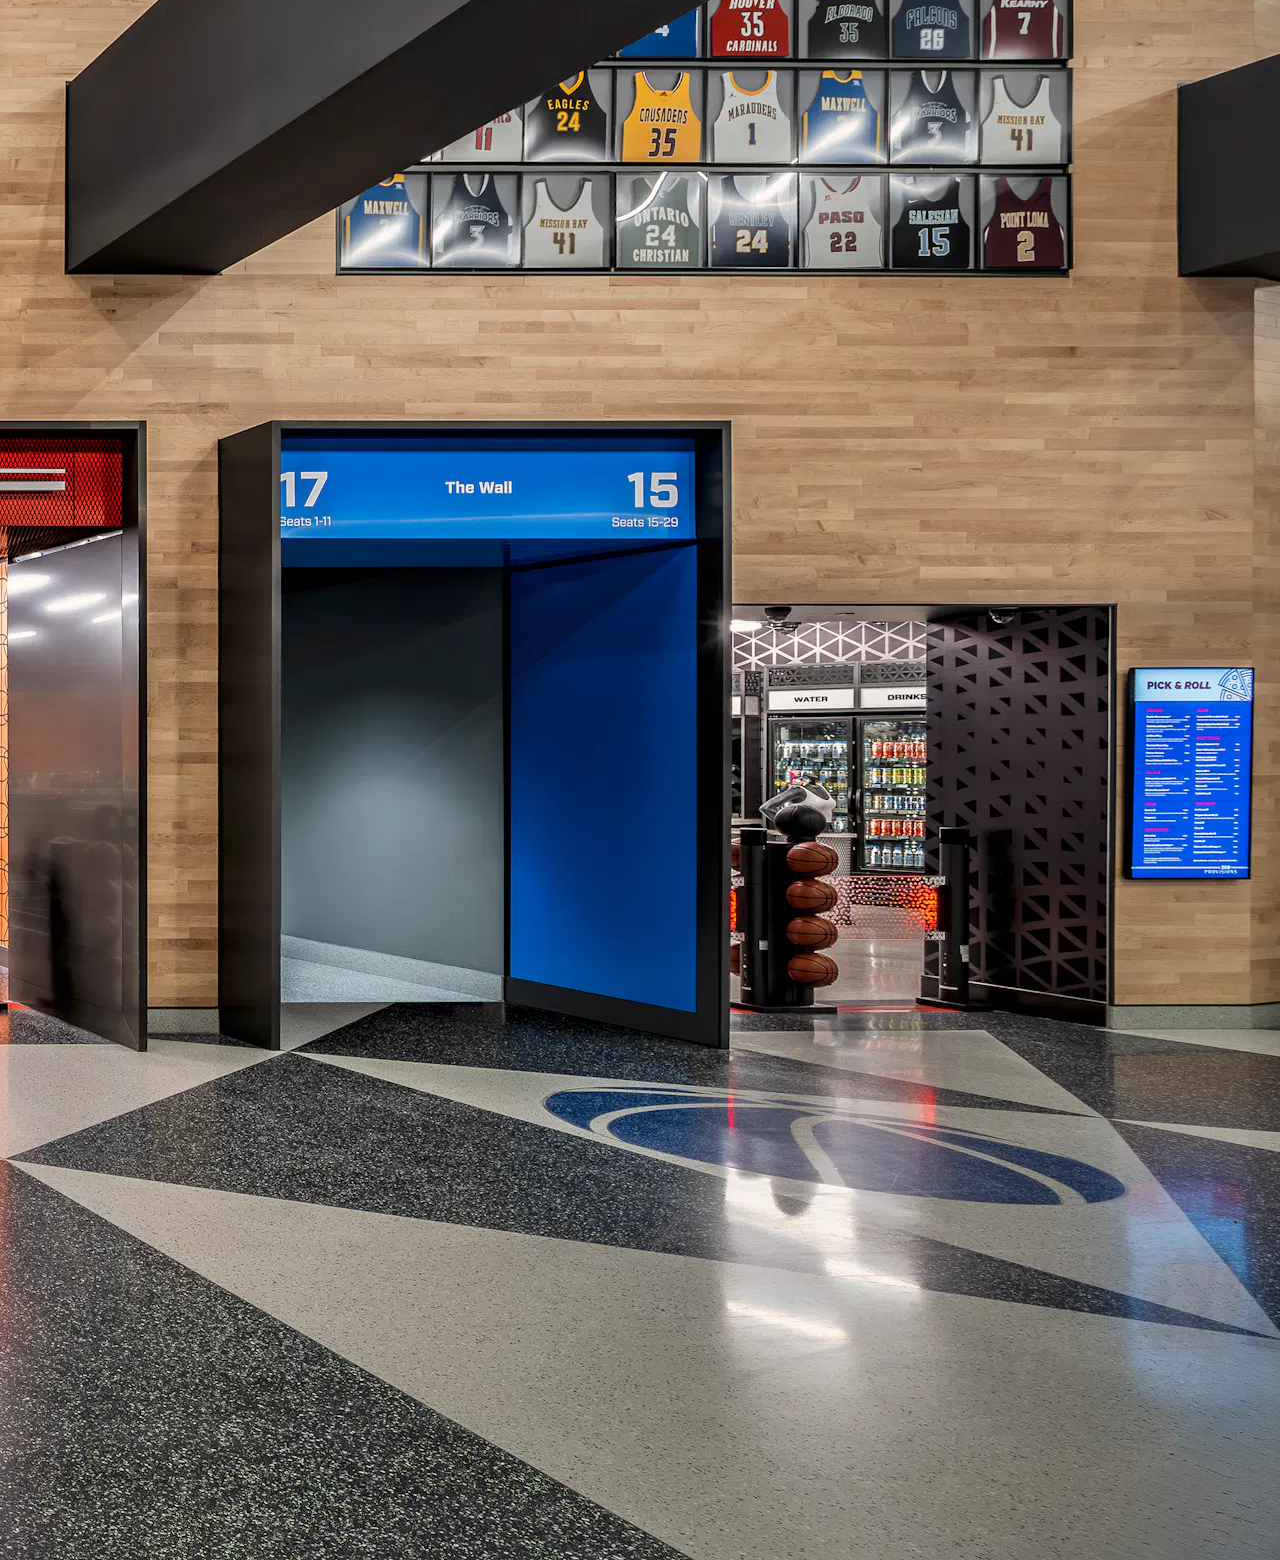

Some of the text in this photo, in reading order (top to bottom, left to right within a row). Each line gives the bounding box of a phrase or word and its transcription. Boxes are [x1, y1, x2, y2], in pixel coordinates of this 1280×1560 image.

[740, 12, 764, 37] 35
[906, 6, 957, 30] FALCONS
[1017, 12, 1031, 35] 7
[840, 23, 859, 42] 35
[726, 40, 778, 53] CARDINALS
[548, 99, 590, 111] EAGLES
[728, 102, 777, 122] MARAUDERS
[821, 97, 866, 112] MAXWELL
[557, 112, 580, 132] 24
[639, 108, 688, 124] CRUSADERS
[648, 128, 677, 158] 35
[1011, 129, 1034, 151] 41
[819, 211, 864, 225] PASO
[909, 209, 959, 226] SALESIAN
[1000, 212, 1049, 228] POINT LOMA
[736, 230, 769, 254] 24
[829, 232, 858, 253] 22
[918, 228, 951, 257] 15
[633, 248, 689, 263] CHRISTIAN
[280, 471, 328, 507] 17
[445, 481, 512, 494] The Wall
[627, 471, 678, 508] 15
[280, 516, 331, 528] Seats 1-11
[612, 516, 679, 528] Seats 15-29
